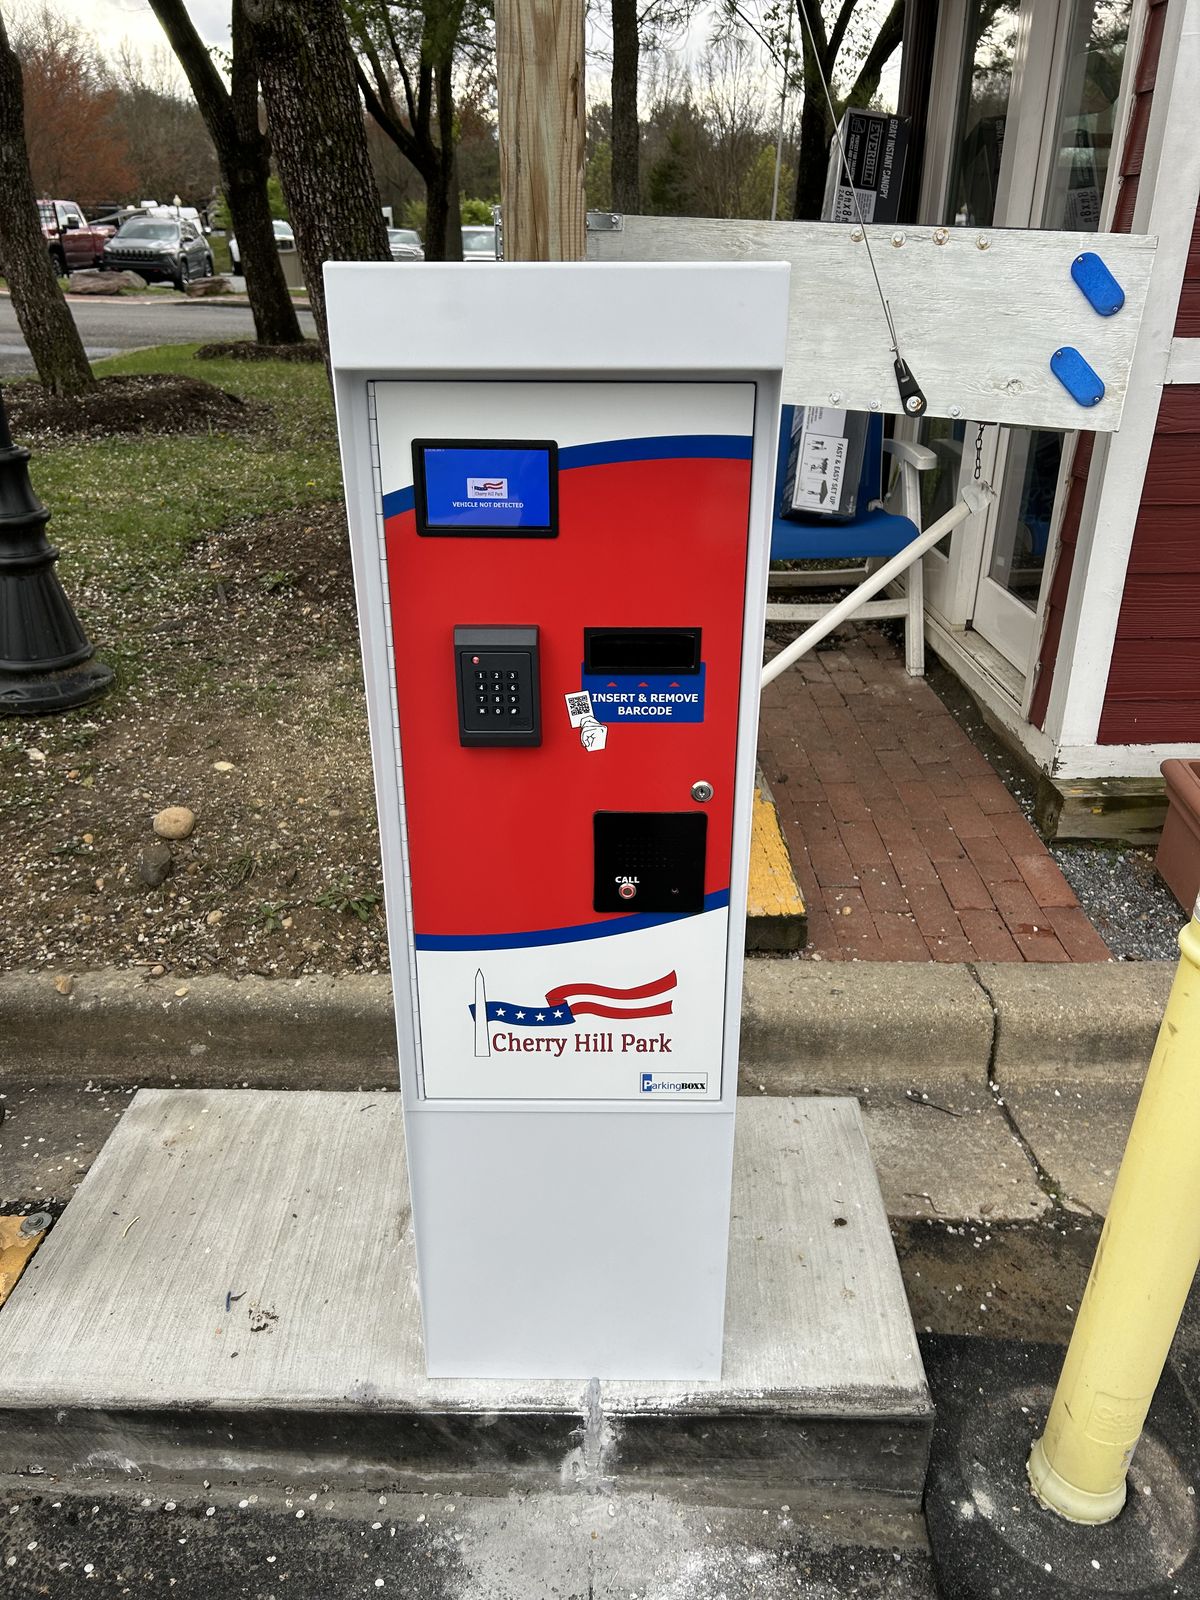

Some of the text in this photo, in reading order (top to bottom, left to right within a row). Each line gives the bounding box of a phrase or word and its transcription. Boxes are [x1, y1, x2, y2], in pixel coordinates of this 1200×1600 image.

[864, 124, 881, 184] EVERBILT
[880, 119, 898, 199] GRAY INSTANT CANOPY
[836, 442, 844, 458] FAST
[833, 465, 841, 482] EASY
[830, 482, 839, 495] SET
[829, 495, 836, 505] UP
[592, 693, 699, 703] INSERT & REMOVE
[617, 706, 673, 716] BARCODE
[614, 876, 640, 884] CALL
[492, 1032, 672, 1057] Cherry Hill Park
